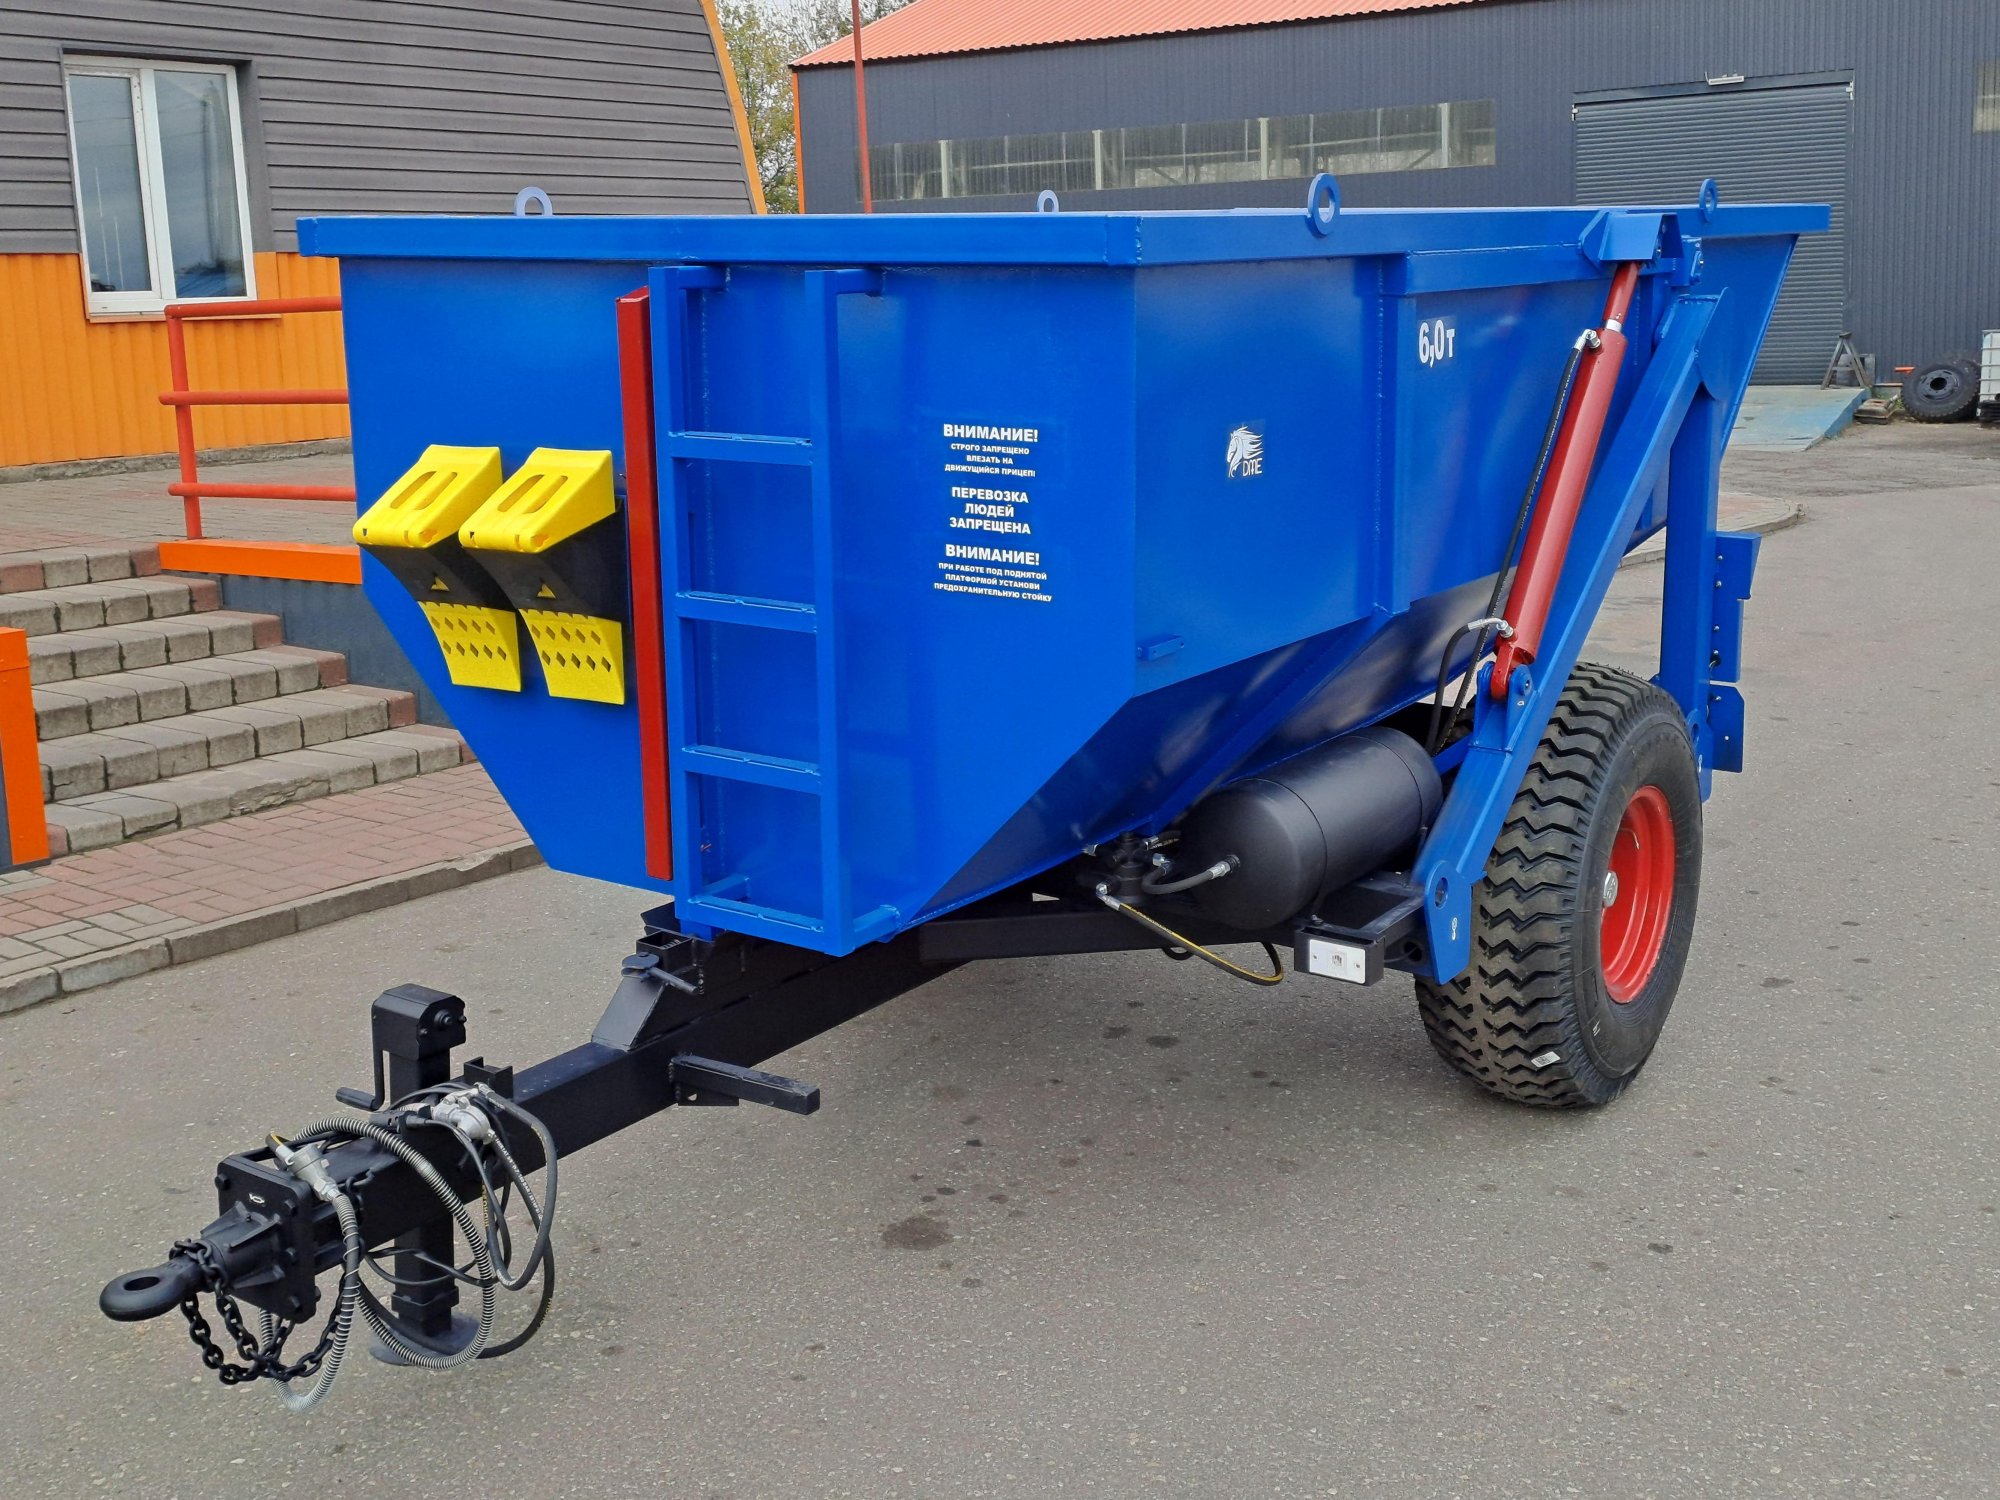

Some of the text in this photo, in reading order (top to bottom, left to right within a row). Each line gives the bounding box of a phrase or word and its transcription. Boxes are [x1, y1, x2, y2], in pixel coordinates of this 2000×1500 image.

[943, 423, 1039, 442] ВНИМАНИЕ!
[950, 443, 1030, 455] СТРОГО ЗАПРЕЩЕНО
[944, 464, 1000, 474] ДВИЖУЩИЙСЯ
[966, 455, 1014, 465] ВЛЕЗАТЬ НА
[951, 486, 1029, 503] ПЕРЕВОЗКА
[964, 503, 1015, 518] ЛЮДЕЙ
[949, 517, 1031, 535] ЗАПРЕЩЕНА
[945, 543, 1040, 566] ВНИМАНИЕ!
[938, 562, 1048, 581] ПРИ РАБОТЕ ПОД ПОДНЯТОЙ
[945, 573, 1040, 591] ПЛАТФОРМОЙ УСТАНОВИ
[933, 582, 1053, 602] ПРЕДОХРАНИТЕЛЬНУЮ СТОЙКУ
